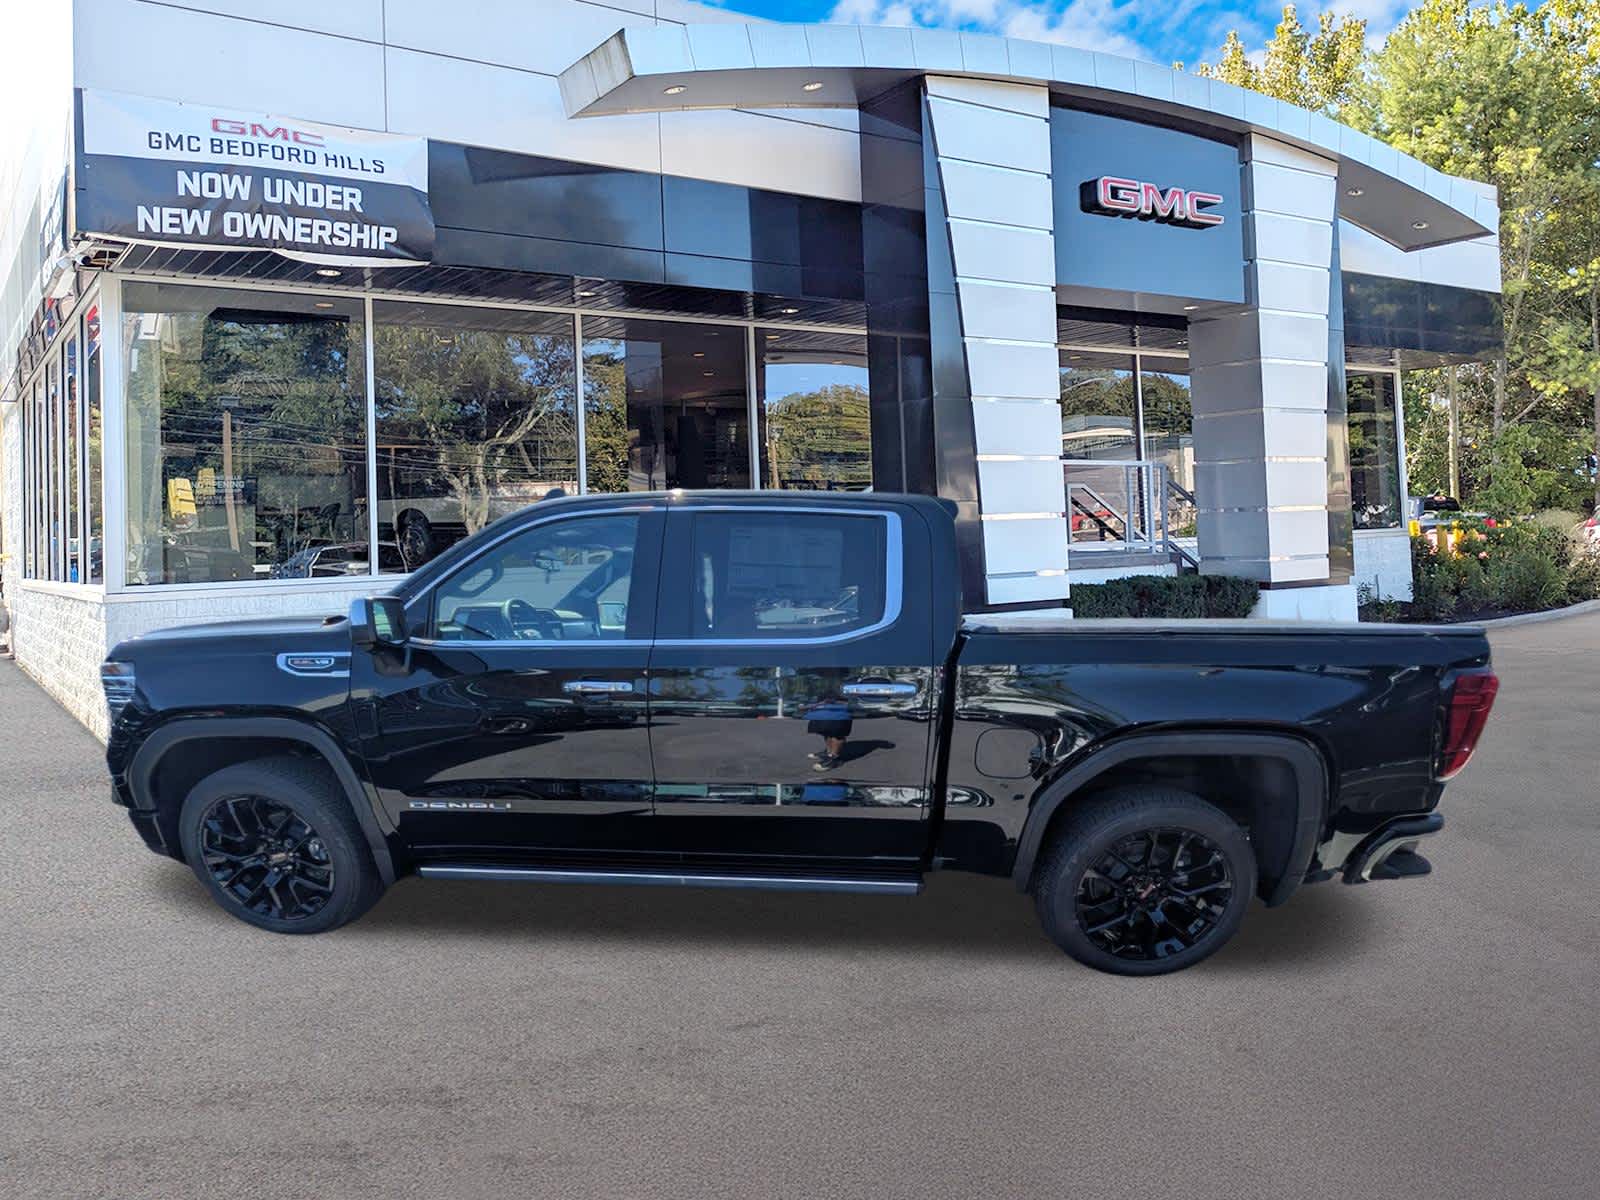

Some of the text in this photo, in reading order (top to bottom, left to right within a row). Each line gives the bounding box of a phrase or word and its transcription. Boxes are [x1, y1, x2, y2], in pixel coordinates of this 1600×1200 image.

[148, 131, 385, 174] GMC BEDFORD HILLS
[211, 118, 326, 148] GMC
[176, 170, 364, 213] NOW UNDER
[1099, 175, 1225, 225] GMC
[136, 205, 398, 250] NEW OWNERSHIP
